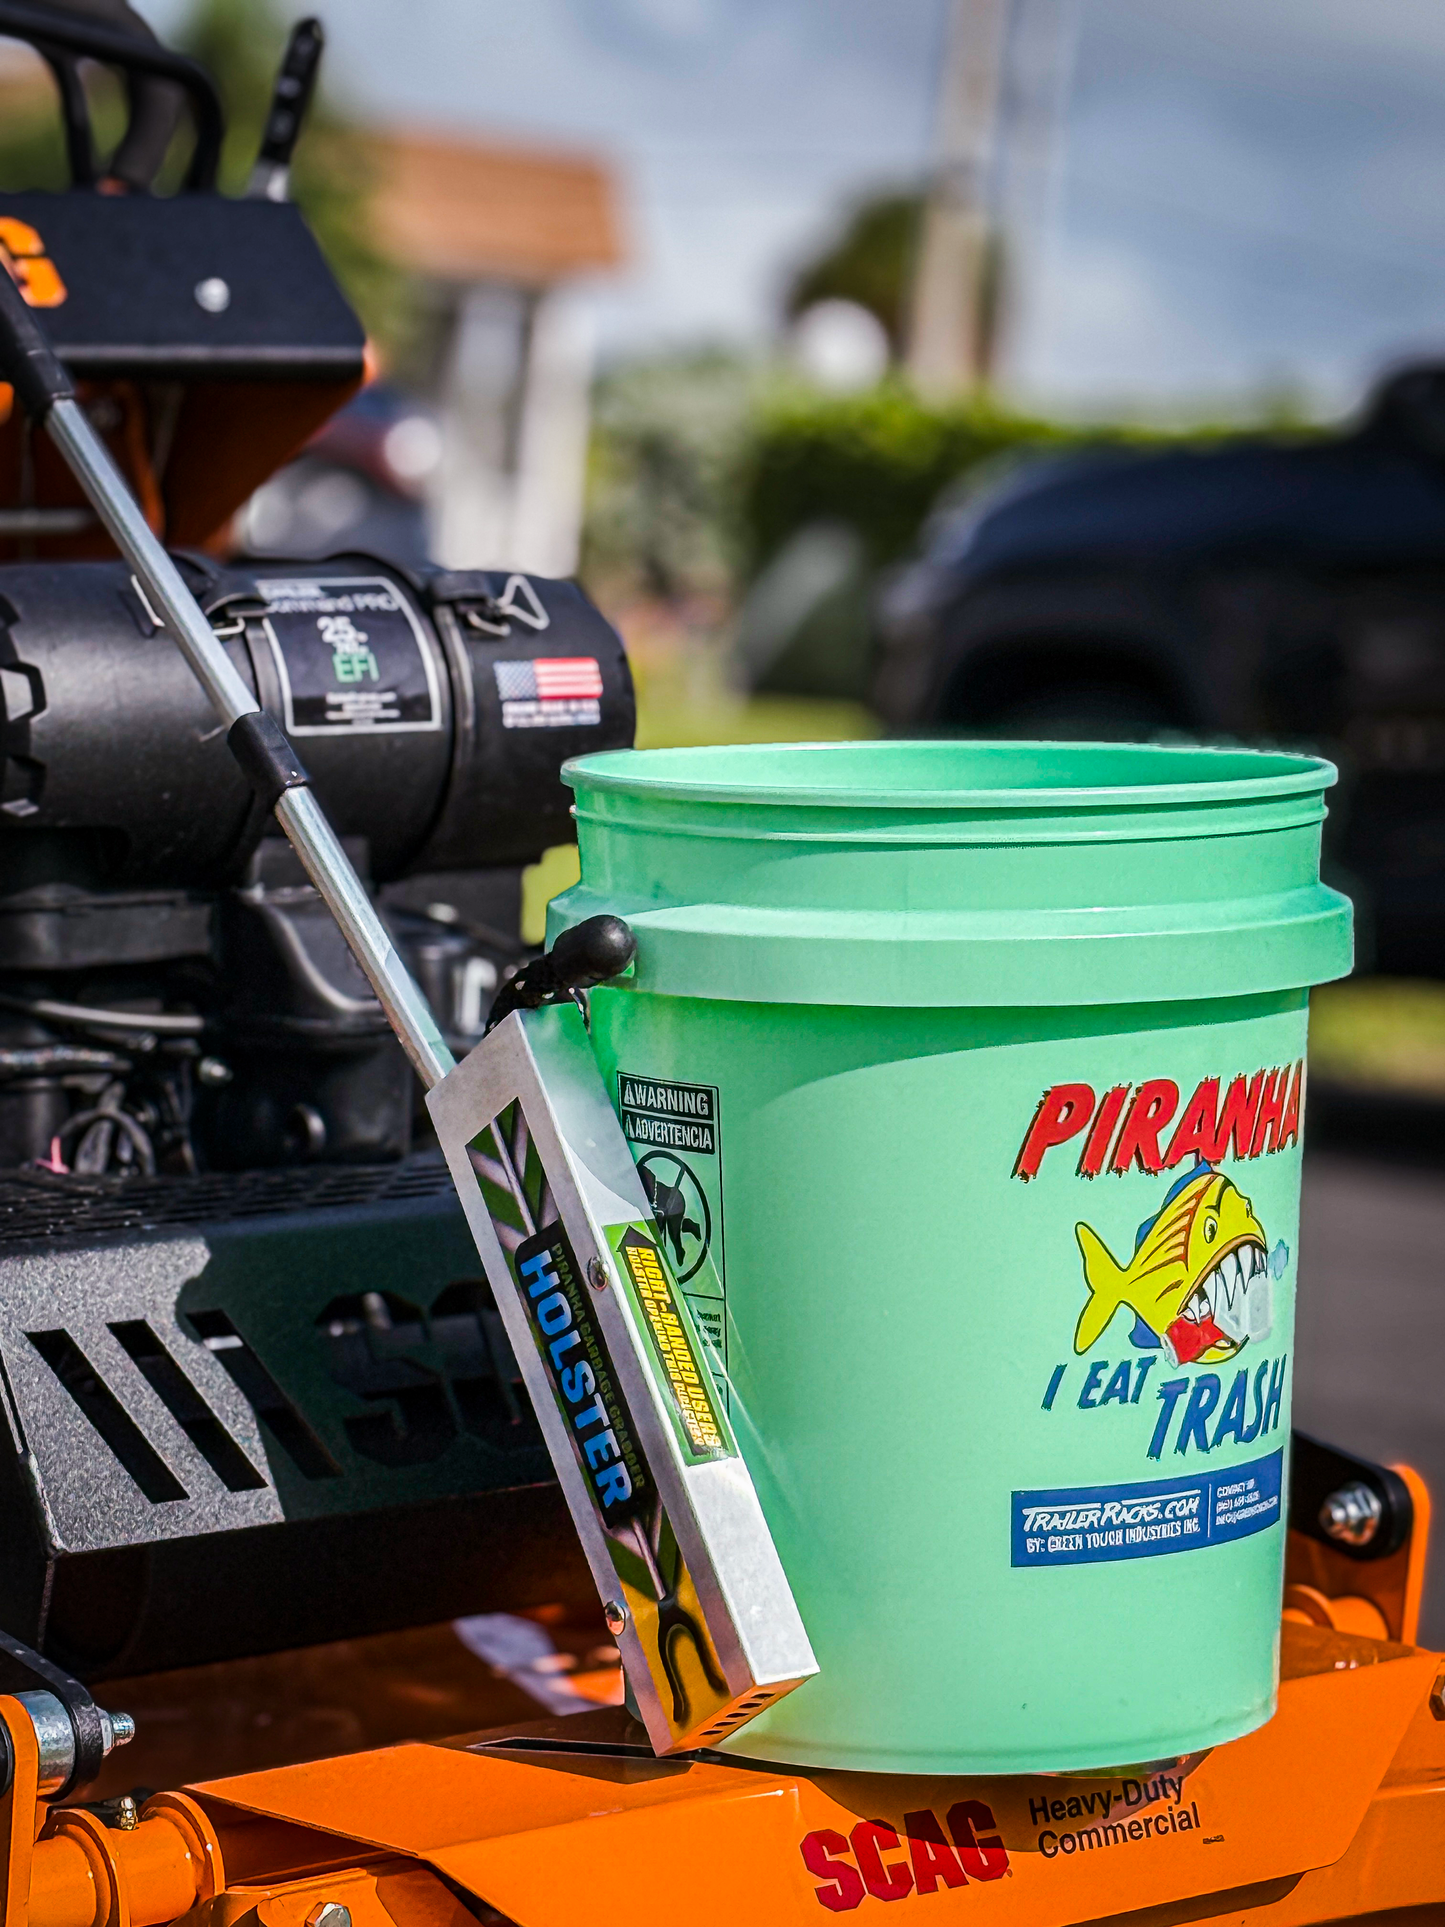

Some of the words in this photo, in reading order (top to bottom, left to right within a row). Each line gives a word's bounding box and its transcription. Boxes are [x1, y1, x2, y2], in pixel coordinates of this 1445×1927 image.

[333, 652, 380, 683] EFI
[633, 1083, 709, 1116] WARNING
[1010, 1058, 1303, 1183] PIRANHA
[635, 1117, 713, 1150] ADVERTENCIA
[520, 1249, 634, 1509] HOLSTER
[551, 1241, 587, 1323] PIRANHA
[580, 1321, 616, 1401] GARBAGE
[608, 1401, 646, 1488] GRABBER
[686, 1386, 722, 1448] USERS
[1041, 1363, 1068, 1411] I
[1077, 1355, 1157, 1409] EAT
[1146, 1353, 1287, 1462] TRASH
[1026, 1538, 1045, 1553] BY:
[1047, 1533, 1083, 1552] GREEN
[1085, 1528, 1123, 1548] TOUCH
[1126, 1520, 1182, 1545] INDUSTRIES
[1029, 1774, 1184, 1826] Heavy-Duty
[800, 1800, 1011, 1912] SCAG
[1037, 1802, 1201, 1859] Commercial
